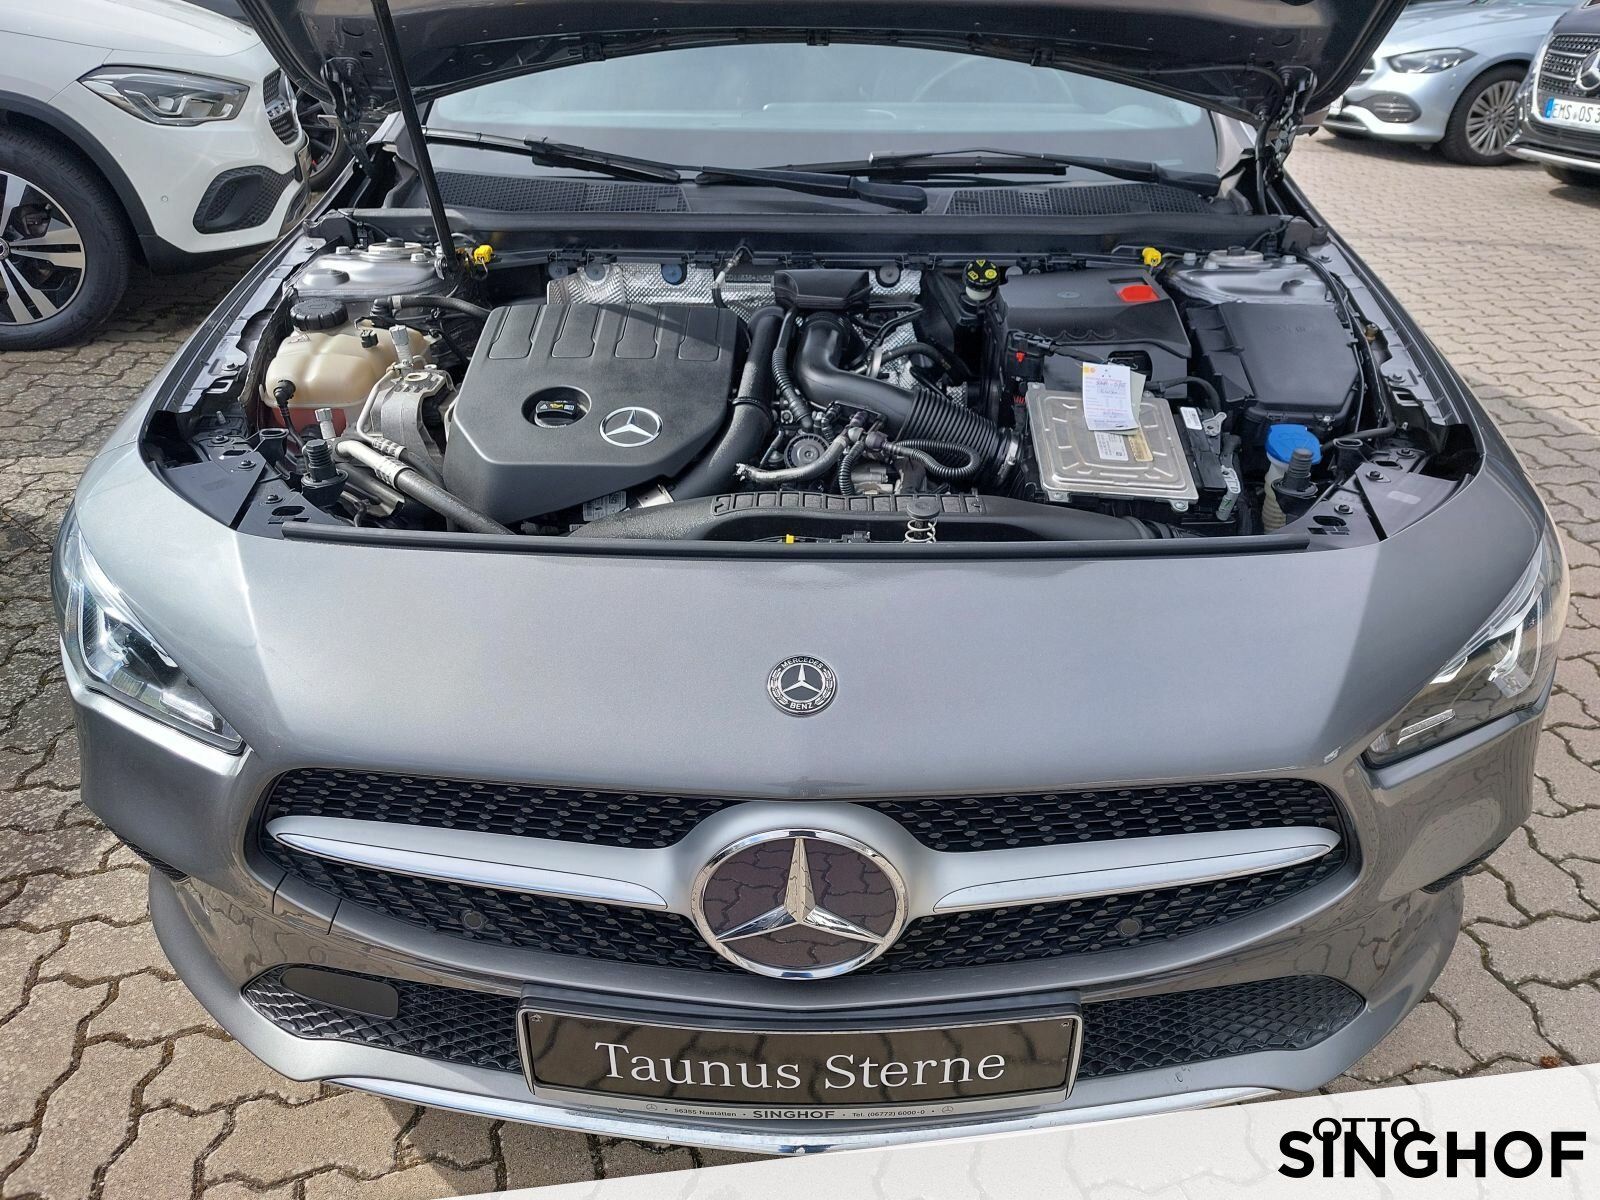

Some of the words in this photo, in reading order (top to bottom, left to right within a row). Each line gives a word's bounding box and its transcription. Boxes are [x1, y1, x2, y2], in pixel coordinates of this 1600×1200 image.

[1552, 103, 1573, 120] EMS
[1579, 106, 1594, 123] OS
[781, 656, 824, 669] MERCEDES
[789, 702, 814, 710] BENZ
[594, 1041, 802, 1090] Taunus
[824, 1053, 1006, 1090] Sterne
[752, 1110, 836, 1119] SINGHOF
[897, 1109, 926, 1117] 6000-0
